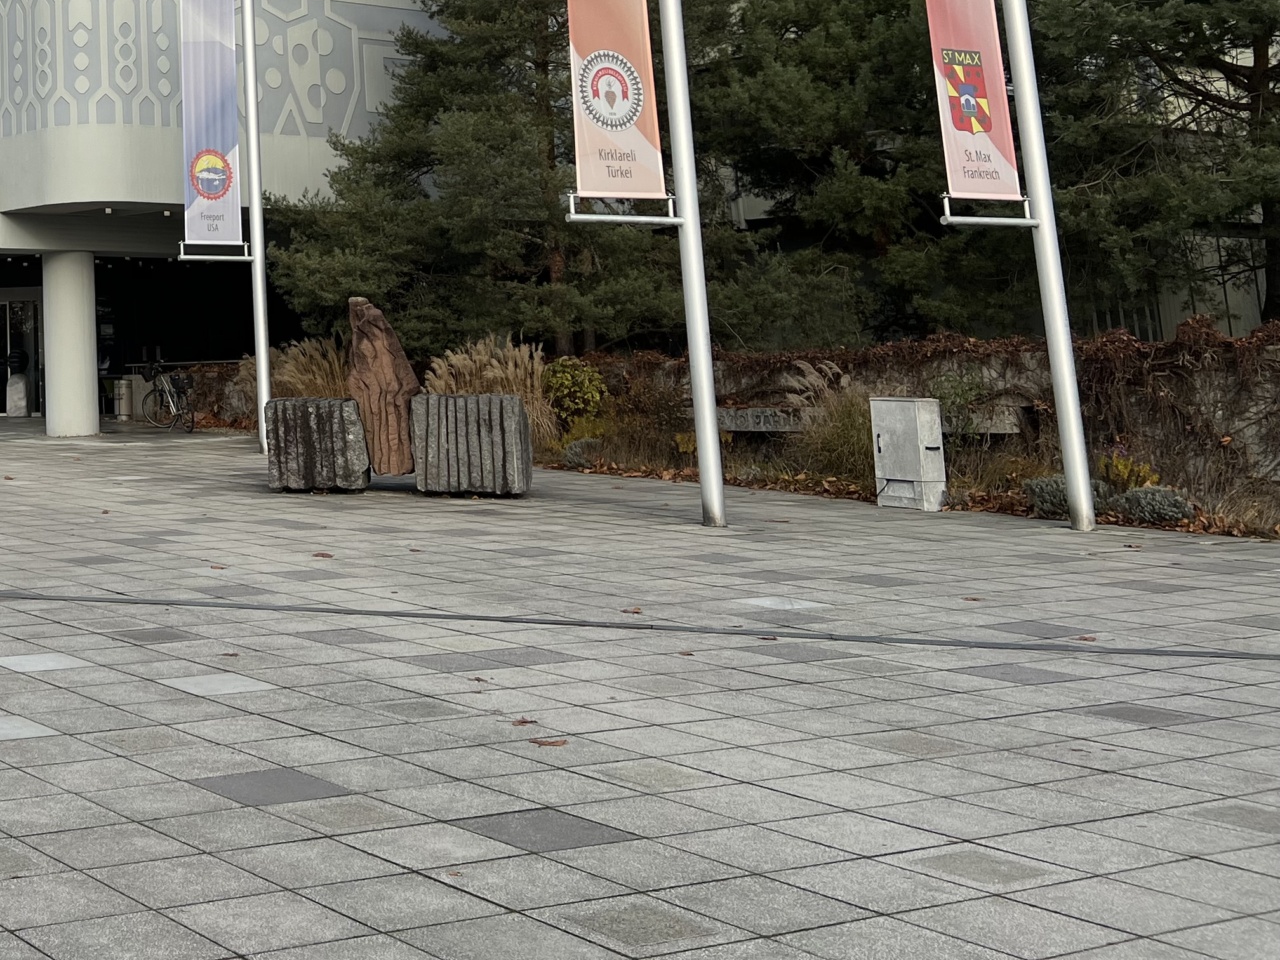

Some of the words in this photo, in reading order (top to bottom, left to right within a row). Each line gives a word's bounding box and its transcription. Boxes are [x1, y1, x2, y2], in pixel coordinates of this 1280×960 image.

[954, 52, 981, 66] MAX
[598, 148, 637, 162] Kirklareli
[964, 149, 976, 163] St.
[976, 150, 992, 164] Max
[606, 165, 633, 179] Türkei
[962, 166, 1001, 180] Frankreich
[200, 212, 225, 222] Freeport
[207, 223, 219, 232] USA
